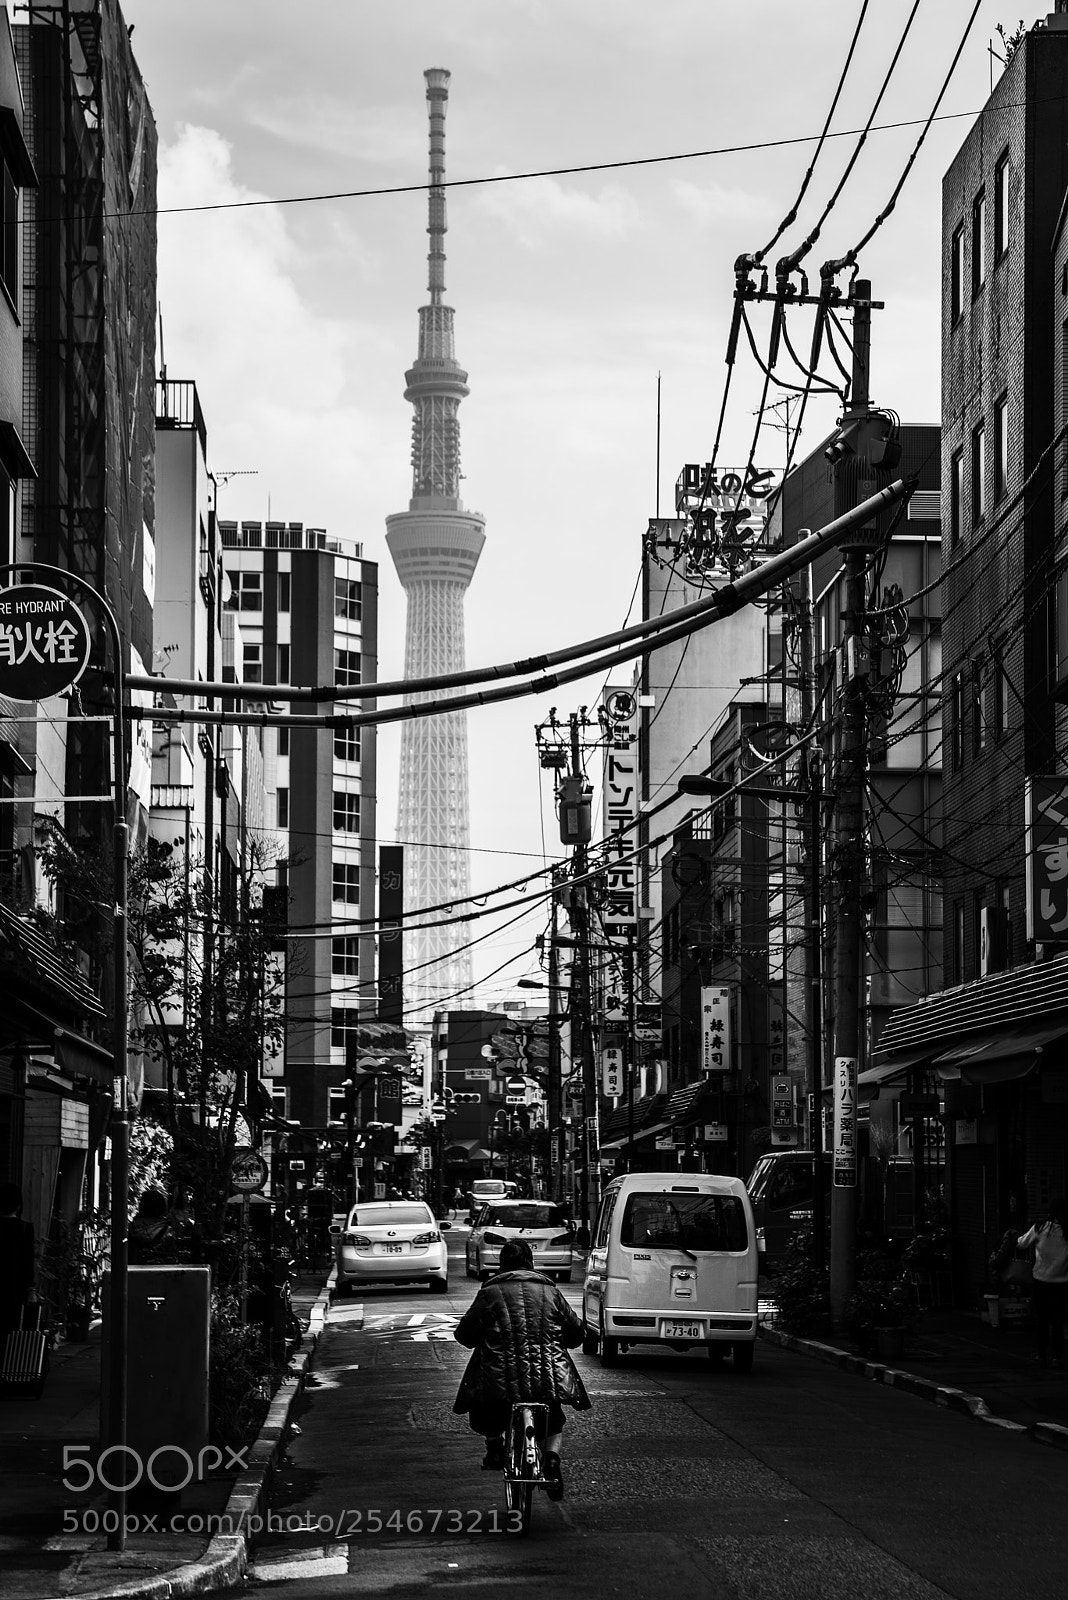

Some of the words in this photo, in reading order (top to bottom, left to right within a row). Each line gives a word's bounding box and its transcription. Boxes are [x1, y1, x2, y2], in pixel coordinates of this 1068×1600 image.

[0, 602, 12, 615] RE
[16, 600, 66, 614] HYDRANT
[615, 925, 629, 935] 1F
[382, 870, 401, 1099] カラオ館
[840, 1088, 854, 1146] ハラ薬局
[672, 1326, 699, 1337] 73-40
